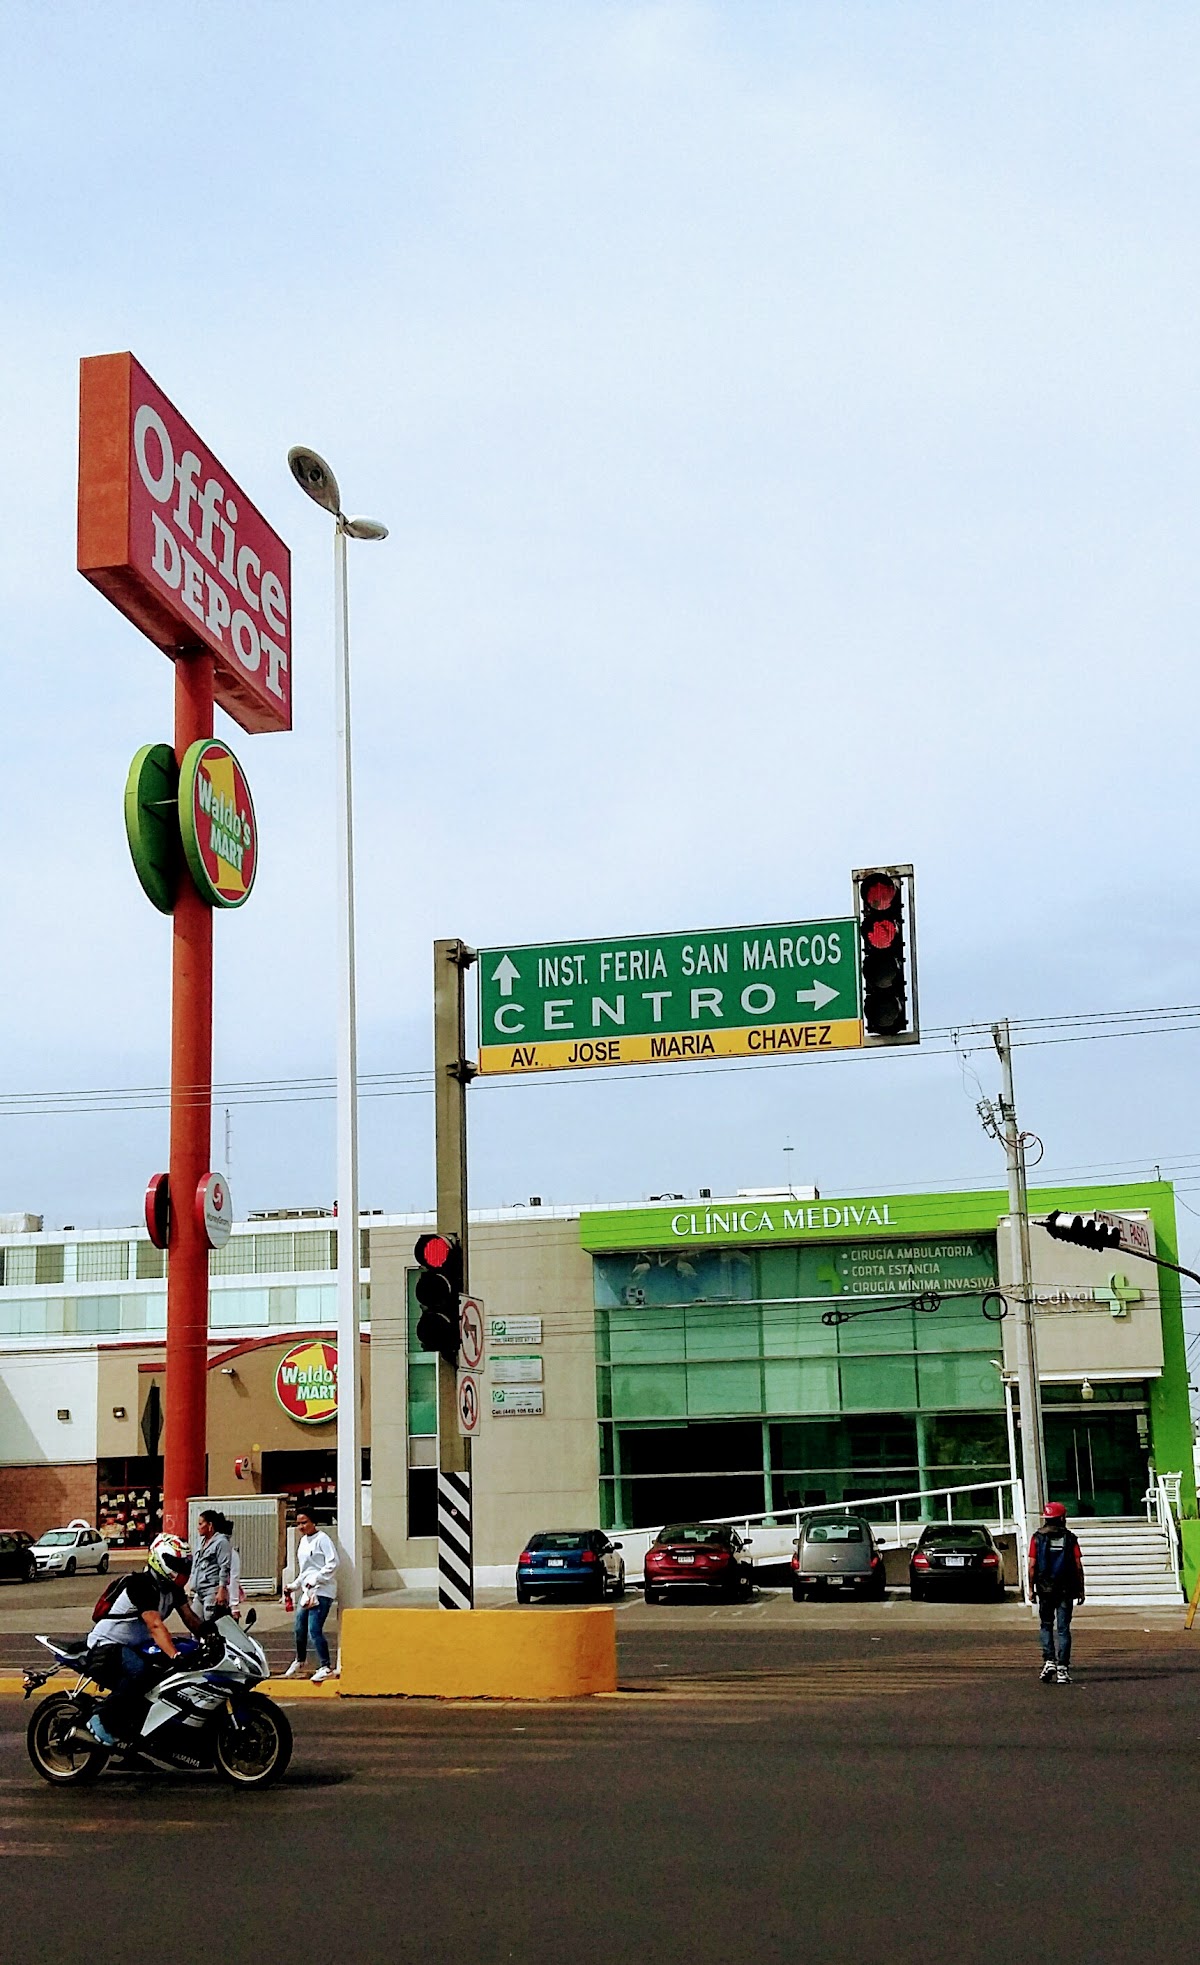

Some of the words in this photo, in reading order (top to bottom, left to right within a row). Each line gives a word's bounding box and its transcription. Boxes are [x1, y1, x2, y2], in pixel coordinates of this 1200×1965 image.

[133, 404, 287, 637] Office
[151, 510, 288, 700] DEPOT
[198, 771, 251, 848] Waldo's
[210, 823, 244, 871] MART
[538, 954, 588, 988] INST.
[600, 948, 668, 983] FERIA
[681, 943, 728, 976] SAN
[743, 932, 842, 971] MARCOS
[493, 983, 776, 1034] CENTRO
[510, 1047, 539, 1068] AV.
[568, 1040, 621, 1063] JOSE
[650, 1034, 715, 1058] MARIA
[747, 1025, 832, 1050] CHAVEZ
[671, 1206, 774, 1236] CLÍNICA
[783, 1203, 898, 1230] MEDIVAL
[850, 1246, 894, 1261] CIRUGÍA
[897, 1245, 973, 1259] AMBULATORIA
[851, 1265, 885, 1277] CORTA
[888, 1263, 940, 1275] ESTANCIA
[852, 1278, 895, 1293] CIRUGÍA
[898, 1277, 941, 1291] MÍNIMA
[943, 1277, 995, 1290] INVASIVA
[281, 1364, 338, 1385] Waldo'
[296, 1385, 336, 1400] MART
[172, 1752, 200, 1768] YAMAHA
